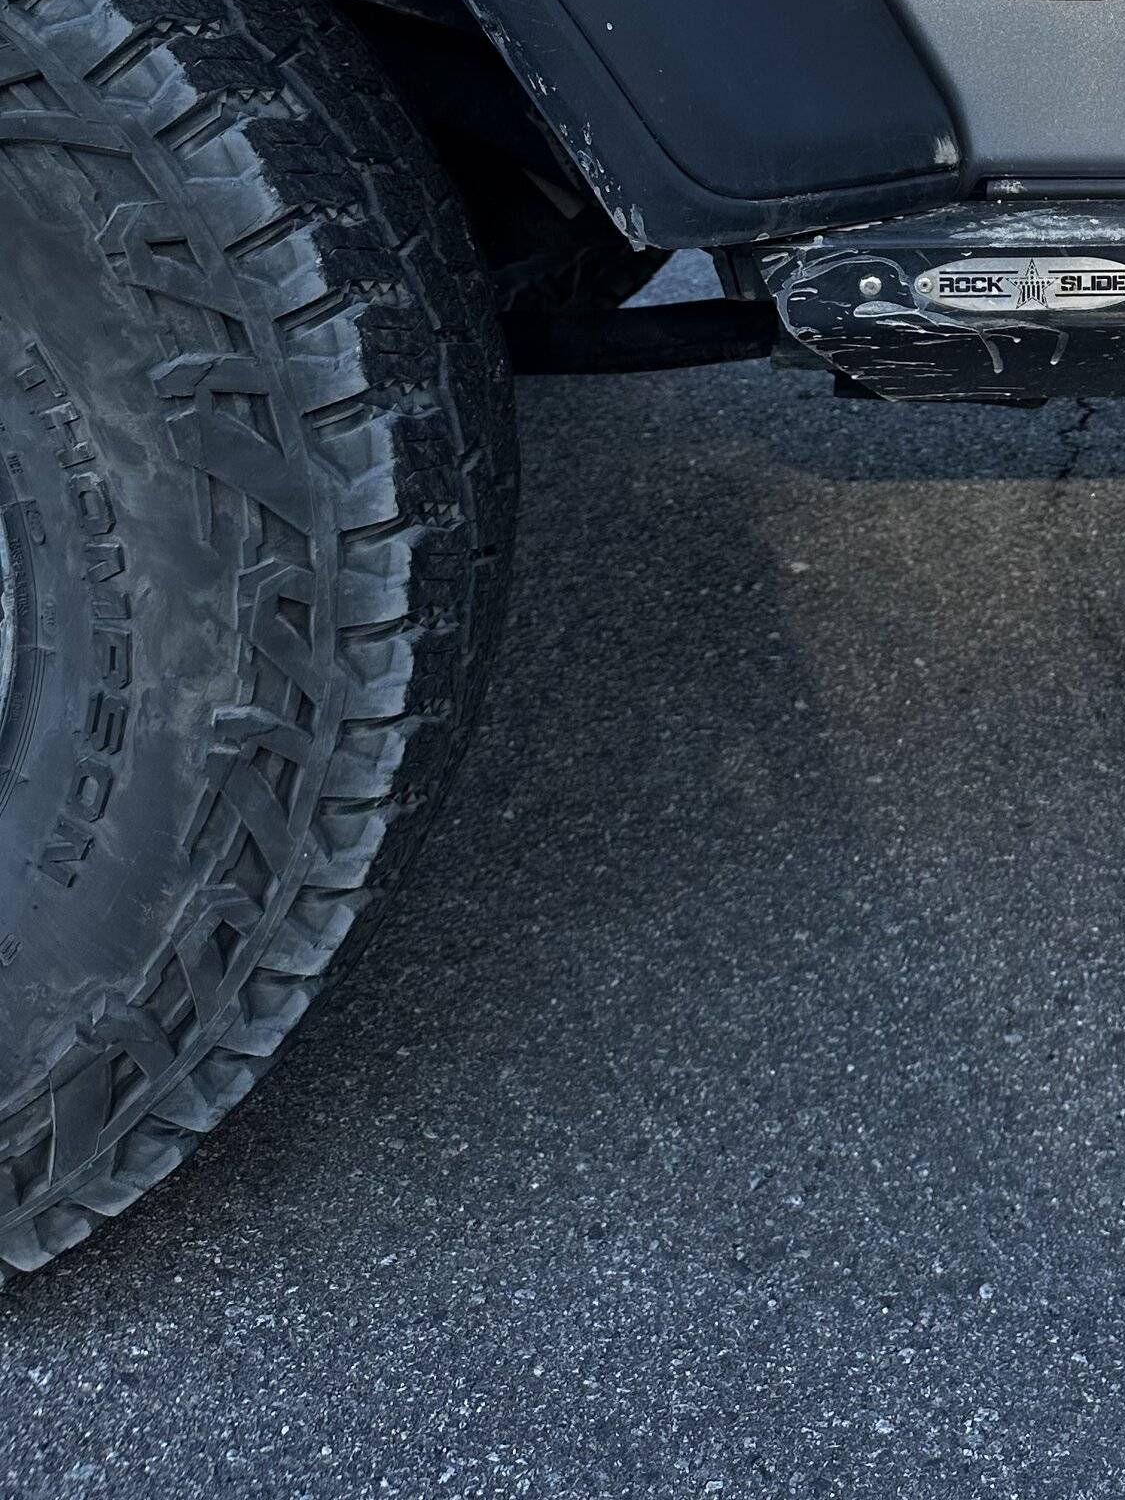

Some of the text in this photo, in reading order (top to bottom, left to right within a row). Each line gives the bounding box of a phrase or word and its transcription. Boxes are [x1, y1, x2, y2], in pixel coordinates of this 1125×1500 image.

[939, 275, 1125, 293] ROCK SLIDE
[16, 341, 132, 889] THOMPSON
